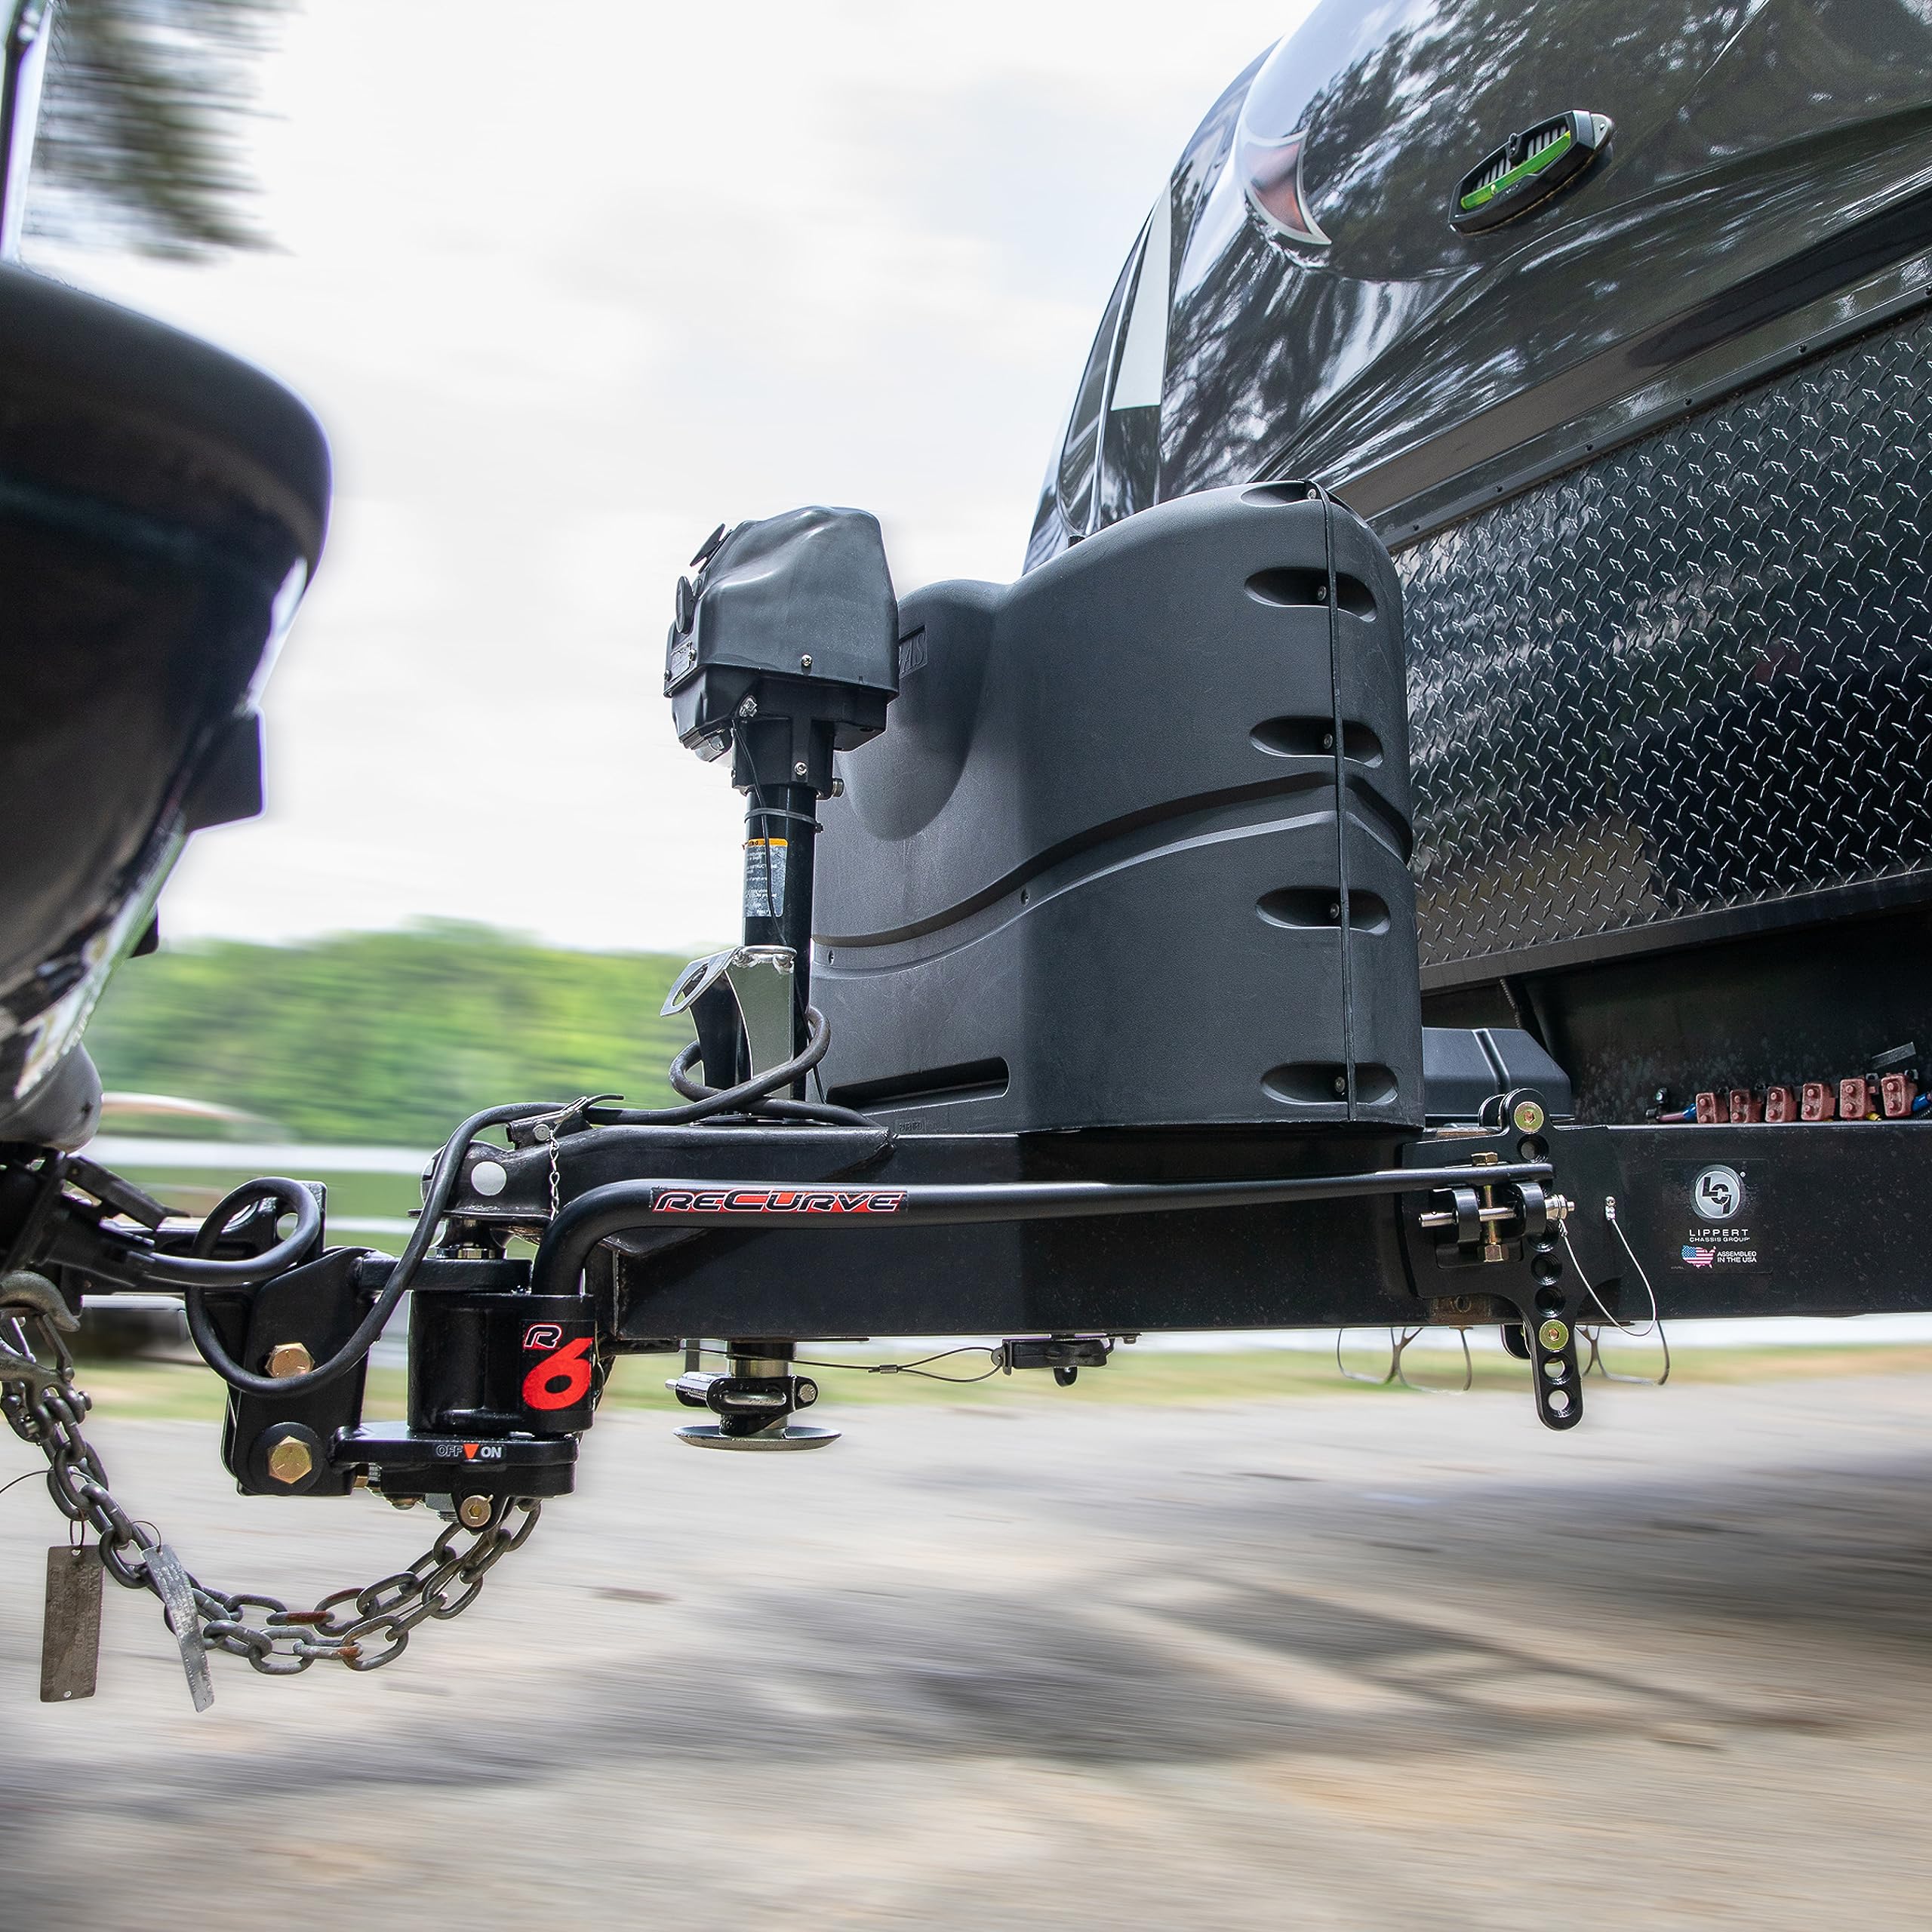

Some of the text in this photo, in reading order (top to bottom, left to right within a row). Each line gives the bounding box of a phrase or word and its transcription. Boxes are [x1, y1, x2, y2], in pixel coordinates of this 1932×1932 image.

[898, 632, 925, 674] AS
[1689, 1229, 1749, 1237] LIPPERT
[436, 1444, 503, 1458] OFF ON
